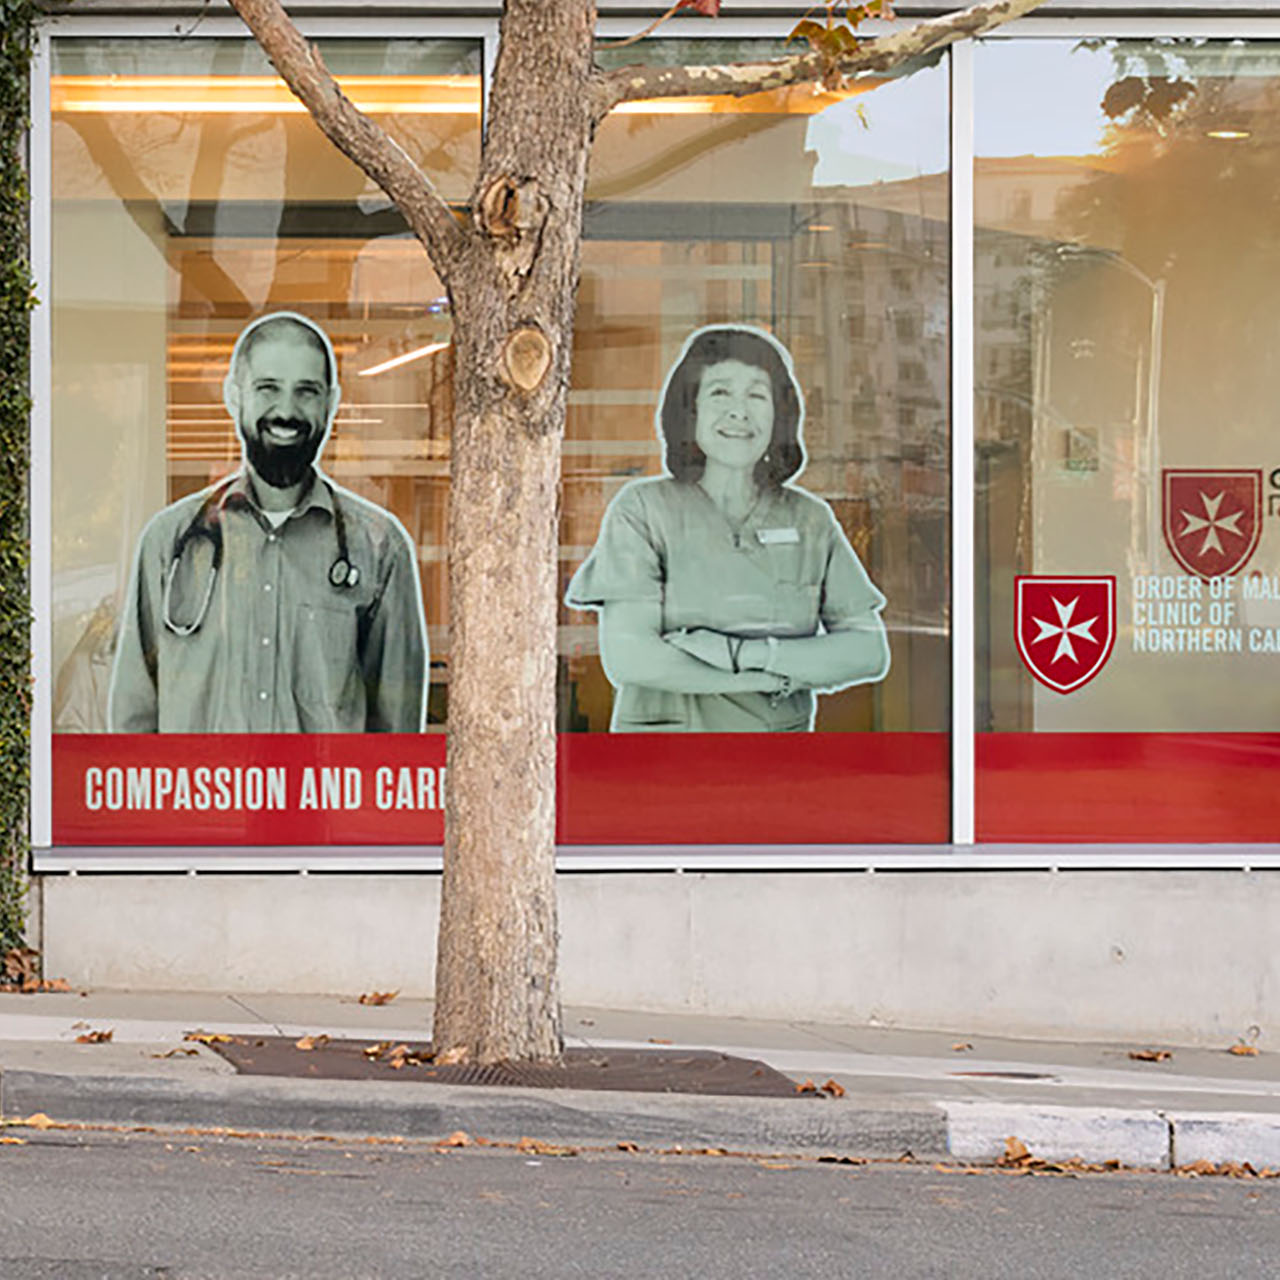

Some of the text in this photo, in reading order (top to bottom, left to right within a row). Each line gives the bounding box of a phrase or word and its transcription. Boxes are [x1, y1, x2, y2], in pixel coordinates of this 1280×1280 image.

[1133, 575, 1203, 600] ORDER
[1209, 575, 1237, 600] OF
[1133, 601, 1236, 626] CLINIC OF
[1133, 628, 1243, 652] NORTHERN
[84, 766, 287, 810] COMPASSION
[299, 766, 363, 810] AND
